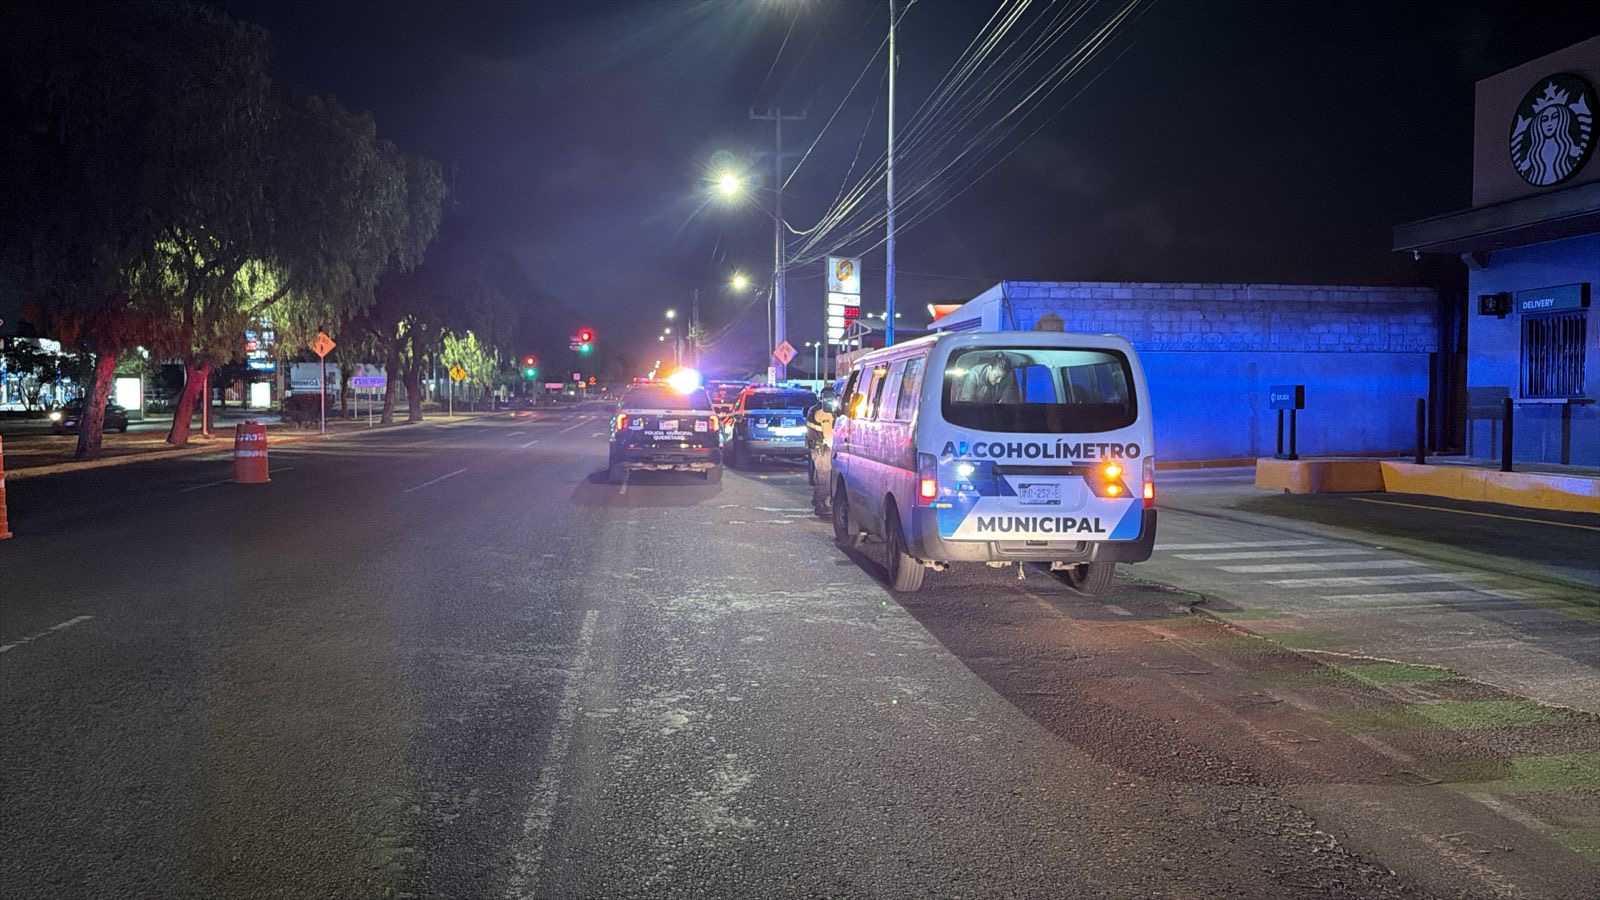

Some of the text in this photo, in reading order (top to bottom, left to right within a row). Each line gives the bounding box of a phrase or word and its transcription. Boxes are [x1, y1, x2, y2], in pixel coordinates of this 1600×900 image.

[1522, 298, 1555, 310] DELIVERY
[940, 438, 1140, 458] ALCOHOLÍMETRO
[977, 517, 1105, 533] MUNICIPAL
